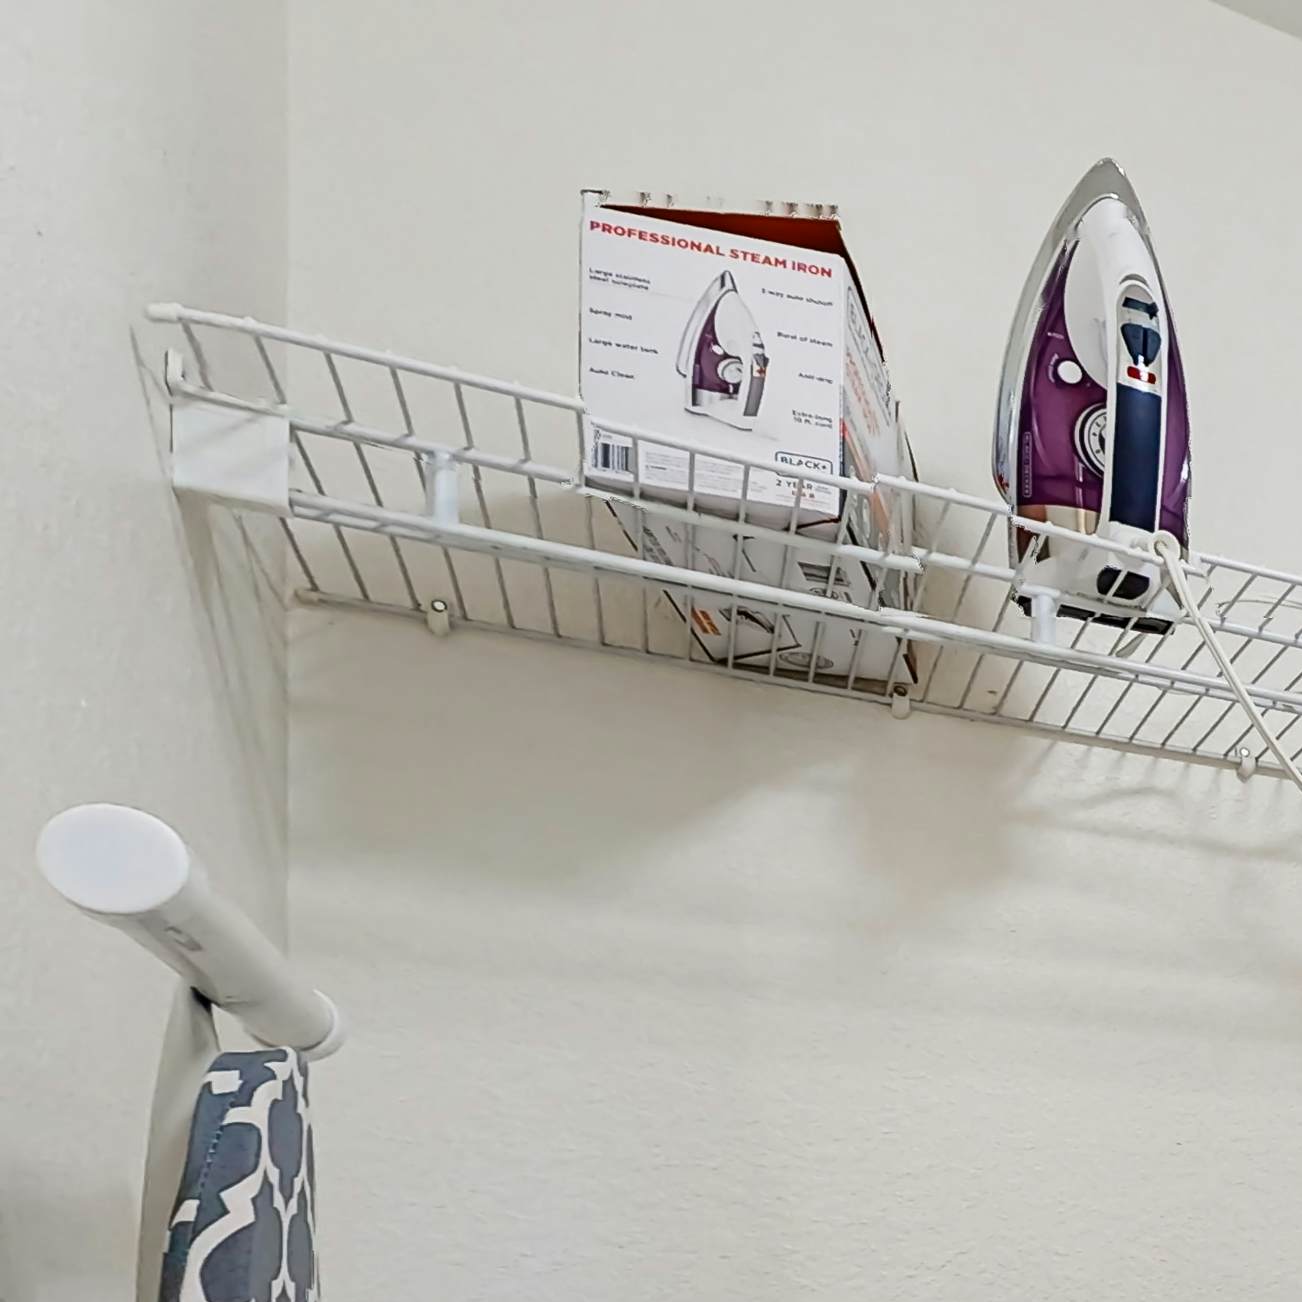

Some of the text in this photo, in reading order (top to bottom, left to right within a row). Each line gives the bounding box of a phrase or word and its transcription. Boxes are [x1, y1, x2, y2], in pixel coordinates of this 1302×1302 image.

[589, 220, 833, 278] PROFESSIONAL STEAM IRON
